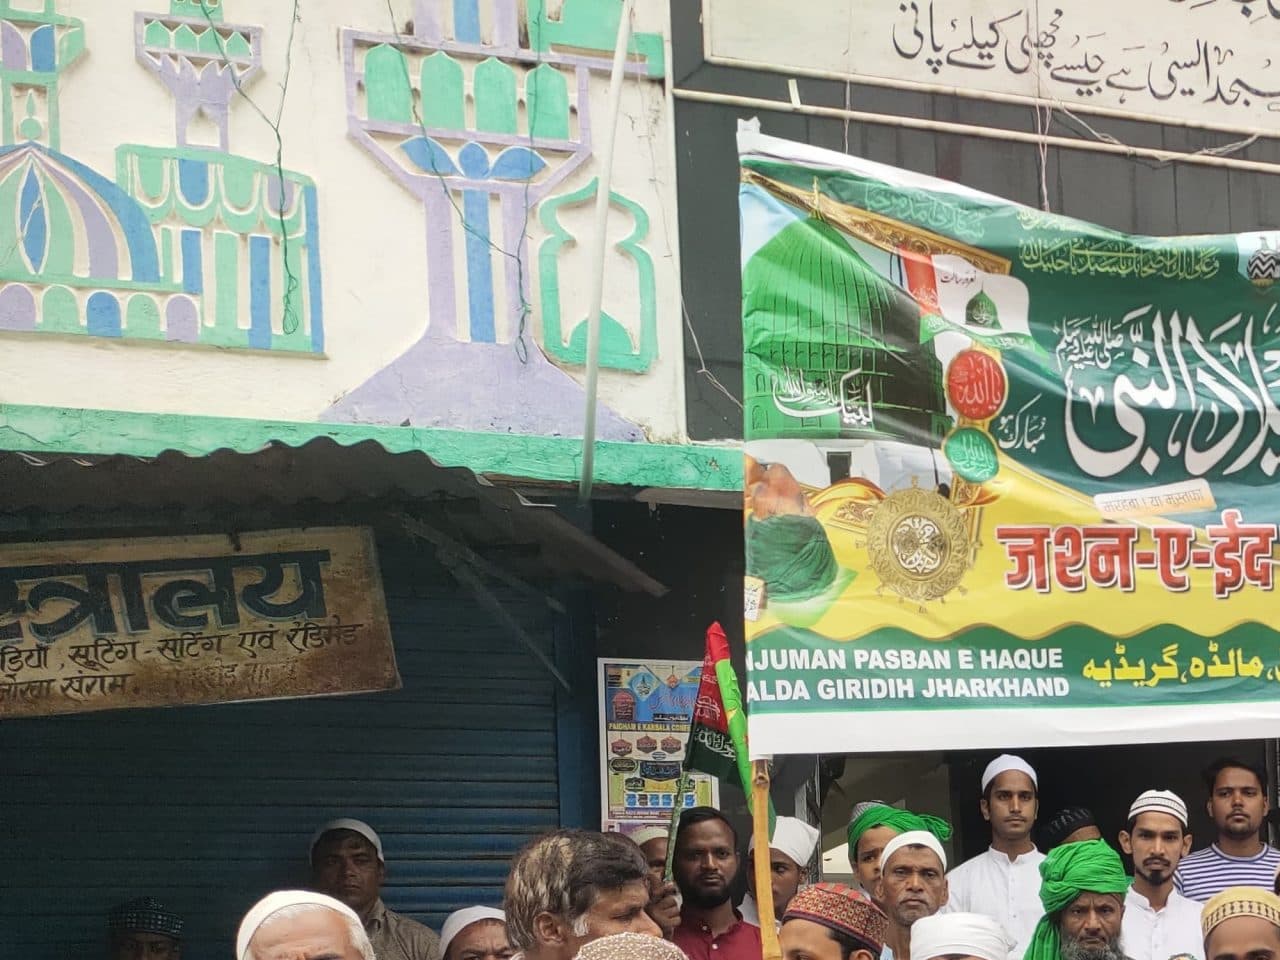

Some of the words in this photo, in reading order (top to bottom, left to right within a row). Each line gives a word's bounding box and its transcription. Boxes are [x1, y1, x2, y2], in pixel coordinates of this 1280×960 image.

[238, 624, 279, 659] एवं
[854, 648, 951, 670] PASBAN
[958, 649, 974, 669] E
[980, 647, 1064, 670] HAQUE
[817, 678, 915, 700] GIRIDIH
[922, 676, 1070, 698] JHARKHAND
